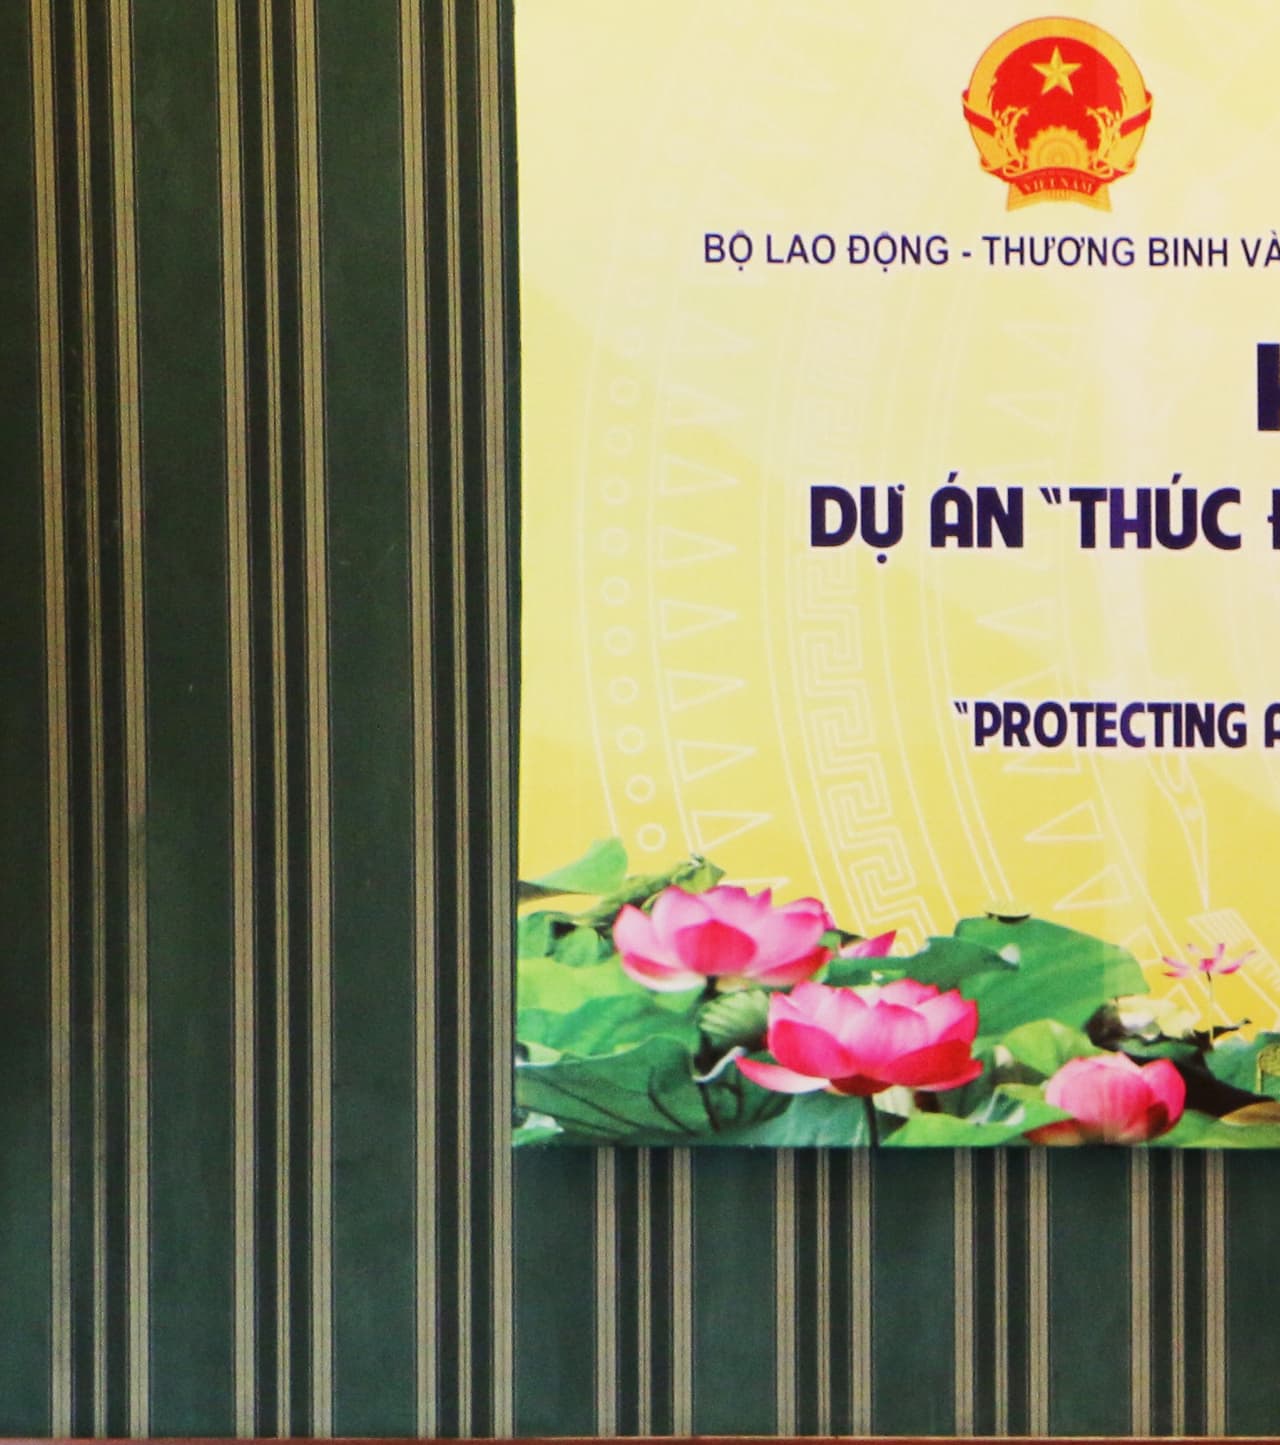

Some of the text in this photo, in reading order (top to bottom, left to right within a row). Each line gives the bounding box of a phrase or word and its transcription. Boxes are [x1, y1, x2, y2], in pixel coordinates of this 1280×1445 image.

[703, 230, 754, 273] BỘ
[765, 232, 837, 266] LAO
[846, 230, 950, 274] ĐỘNG
[980, 233, 1136, 268] THƯƠNG
[1147, 236, 1229, 269] BINH
[809, 482, 906, 565] DỰ
[929, 470, 1025, 550] ÁN
